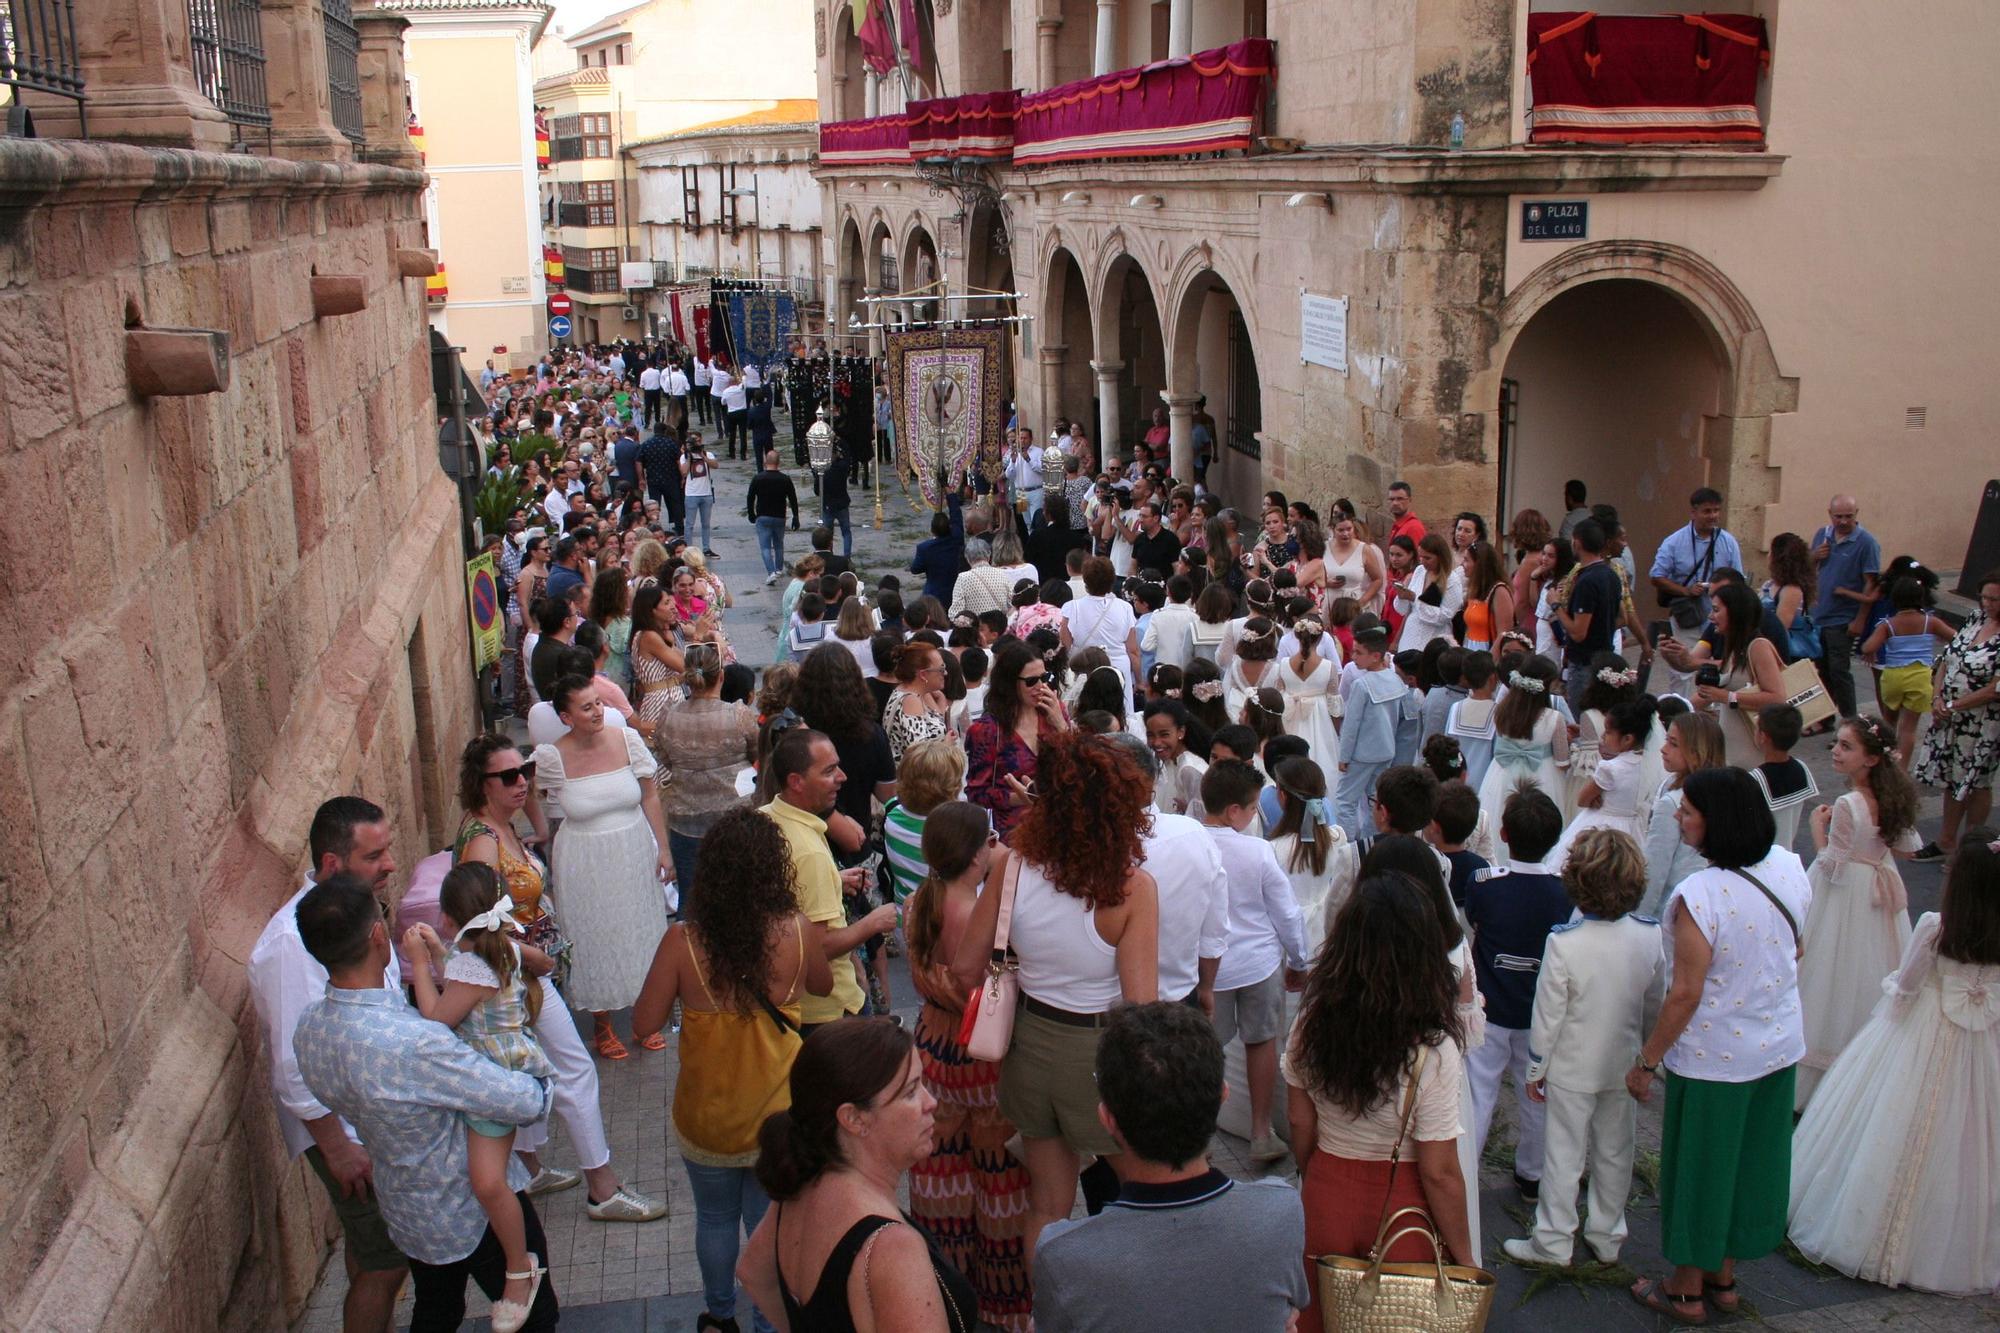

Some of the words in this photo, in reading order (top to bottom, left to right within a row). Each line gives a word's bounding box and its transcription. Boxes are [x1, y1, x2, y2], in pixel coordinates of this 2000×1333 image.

[1547, 205, 1579, 217] PLAZA
[1528, 225, 1548, 236] DEL
[1554, 223, 1581, 234] CAÑO
[1797, 690, 1814, 702] DIOR
